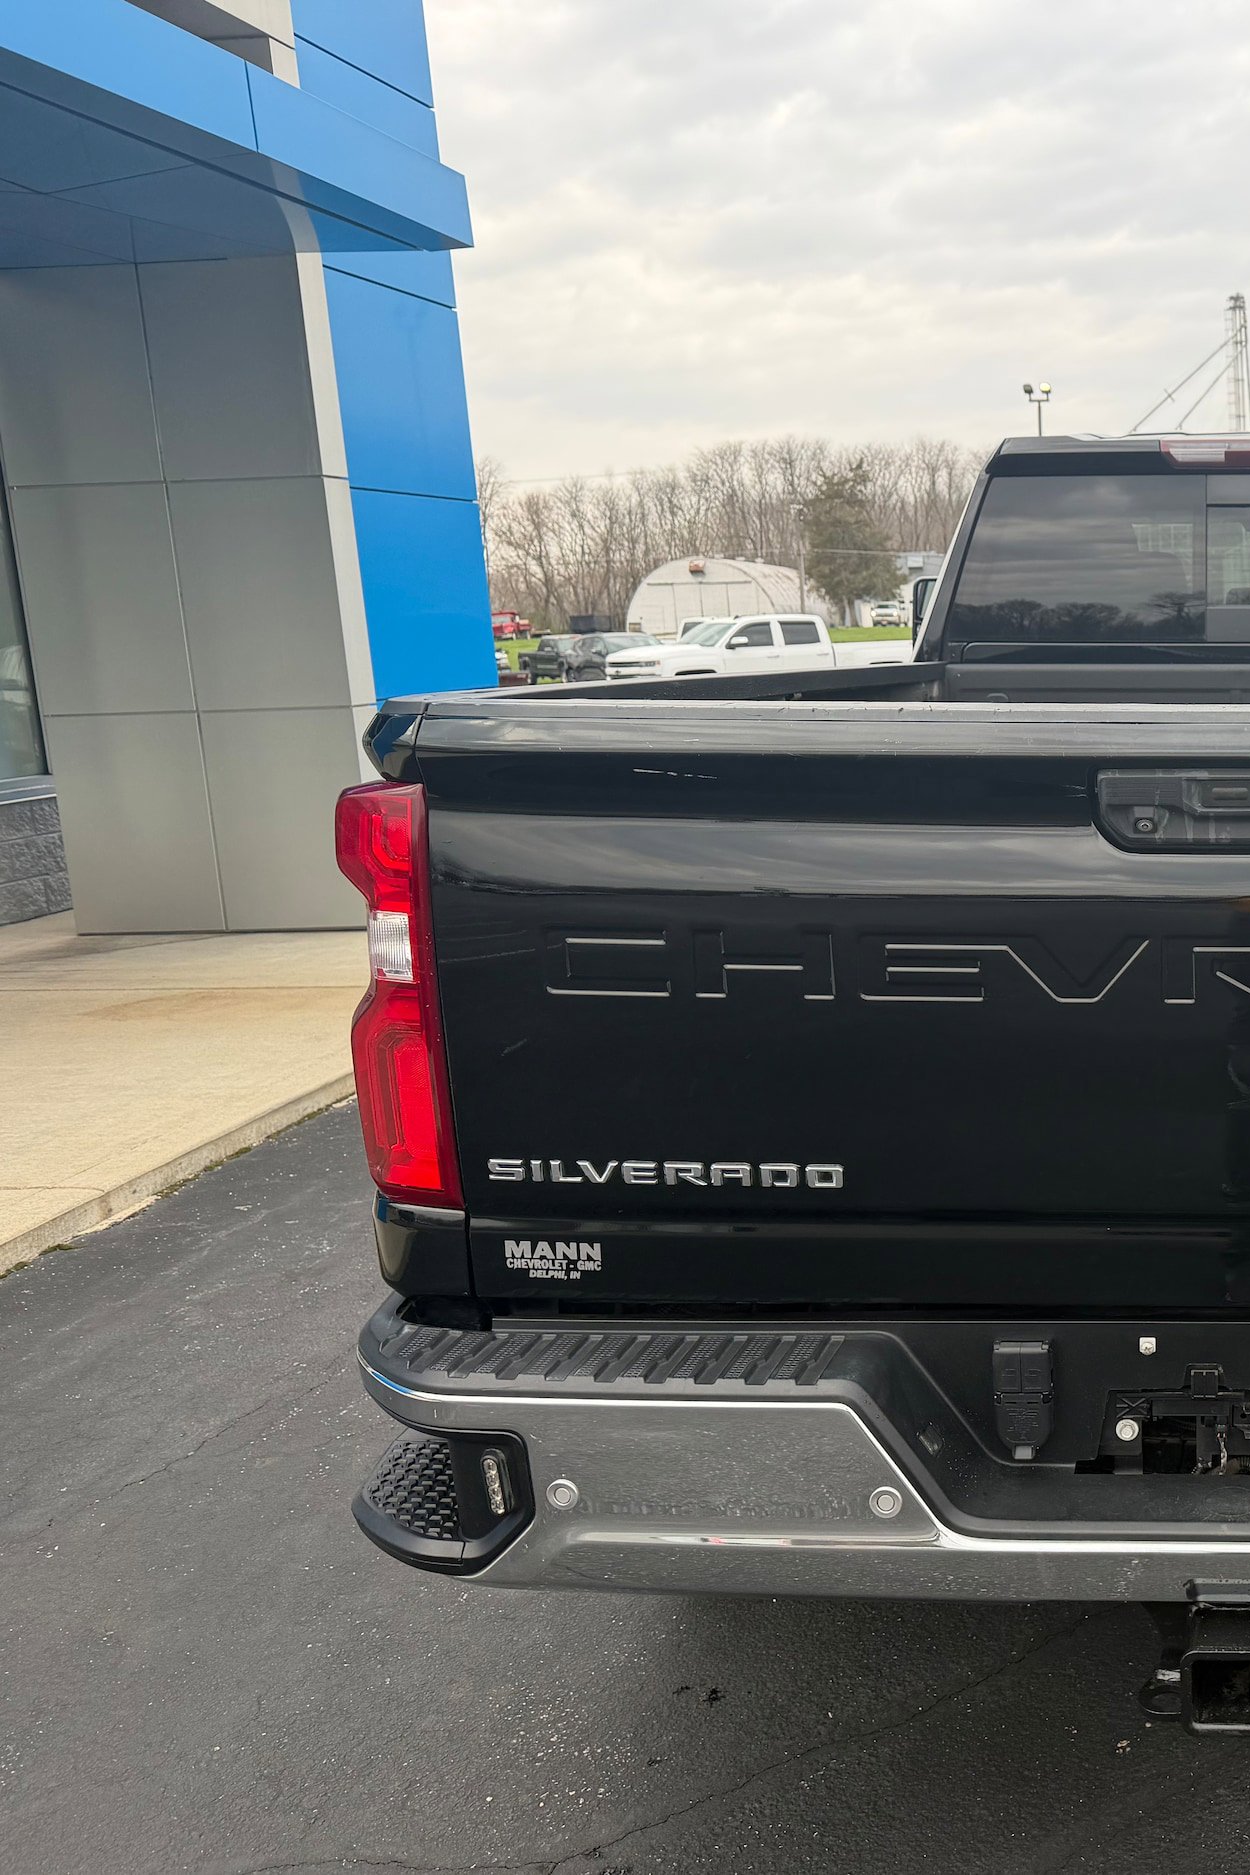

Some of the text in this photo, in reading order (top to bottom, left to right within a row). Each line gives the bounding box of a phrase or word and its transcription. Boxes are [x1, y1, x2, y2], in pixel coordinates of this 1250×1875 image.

[487, 1157, 845, 1189] SILVERADO
[504, 1240, 602, 1261] MANN
[506, 1258, 568, 1270] CHEVROLET
[577, 1260, 602, 1271] GMC
[529, 1269, 581, 1280] DELPHI, IN
